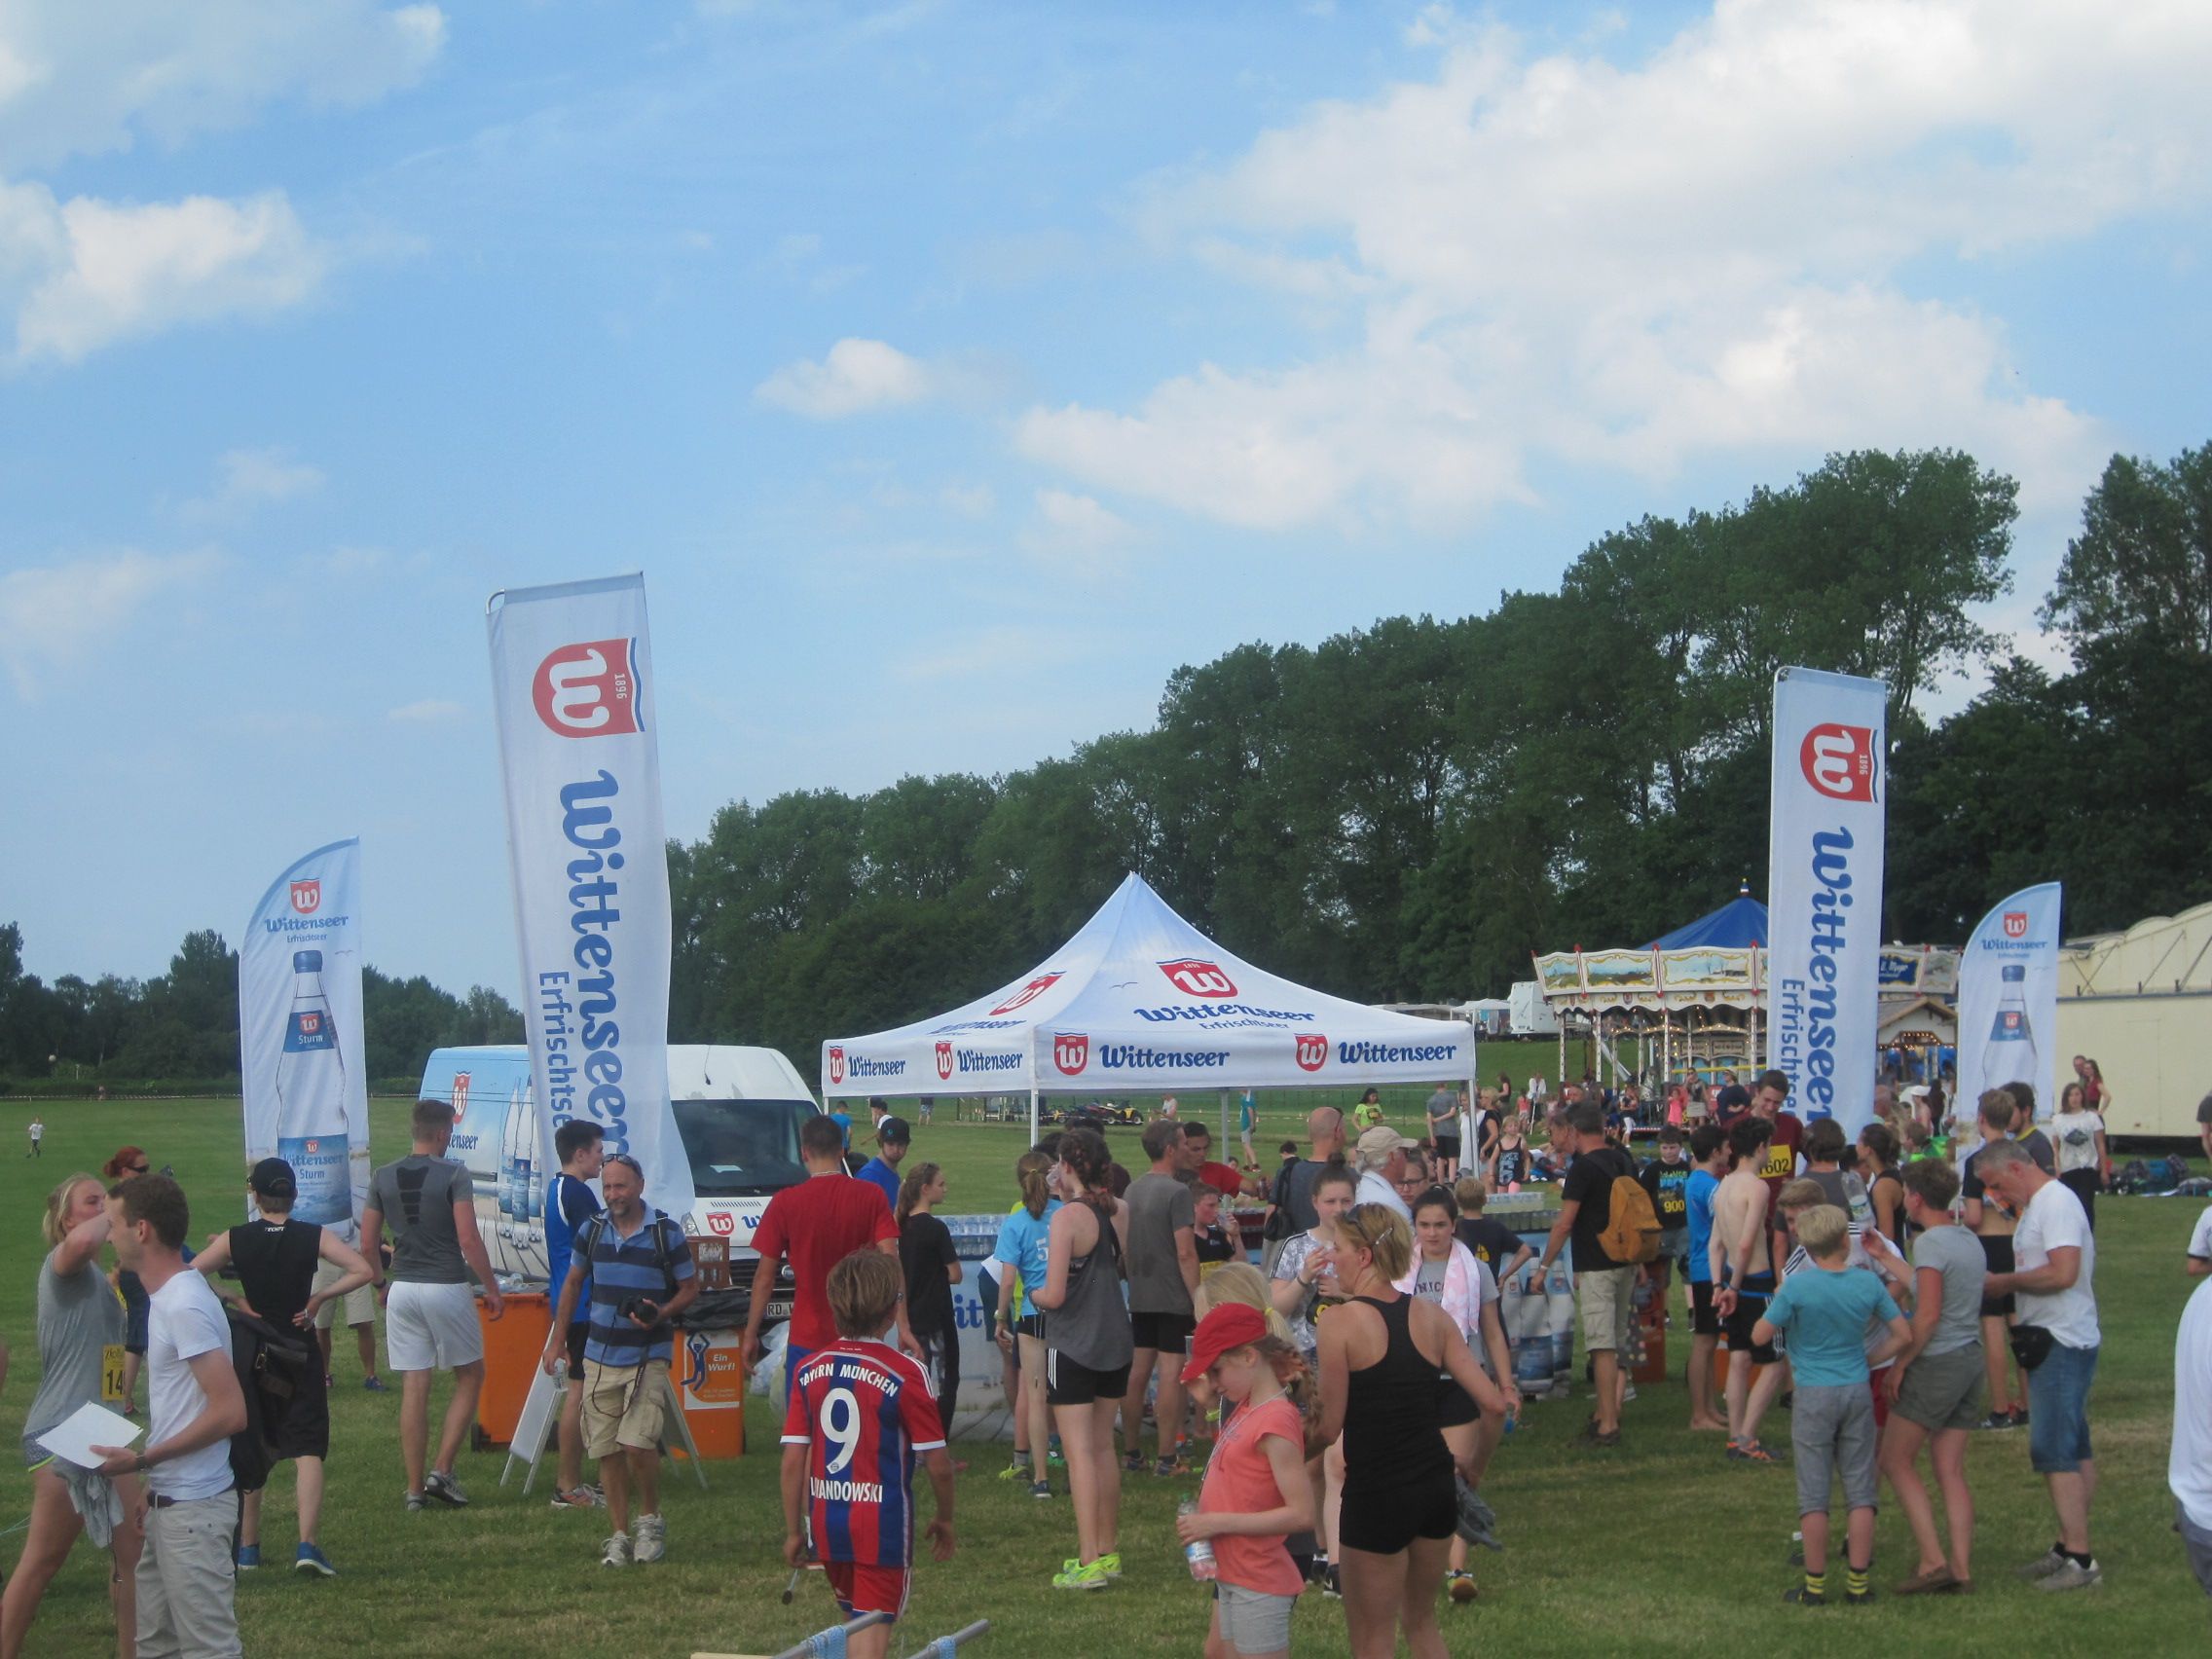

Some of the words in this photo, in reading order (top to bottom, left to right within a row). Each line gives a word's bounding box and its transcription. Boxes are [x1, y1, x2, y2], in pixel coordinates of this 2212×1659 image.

[614, 673, 627, 699] 1896
[265, 916, 350, 933] Wittenseer
[1980, 940, 2047, 950] Wittenseer
[560, 769, 630, 1155] Wittenseer
[1133, 1004, 1315, 1021] Wittenseer
[298, 1033, 323, 1045] Sturm
[539, 972, 577, 1127] Erfrischtse
[1099, 1045, 1231, 1068] Wittenseer
[1338, 1042, 1457, 1064] Wittenseer
[848, 1056, 906, 1078] Wittenseer
[956, 1050, 1023, 1072] Wittenseer
[449, 1133, 478, 1150] enseer
[299, 1169, 325, 1180] Sturm
[1760, 1160, 1789, 1174] 602
[1664, 1199, 1684, 1213] 900
[767, 1304, 783, 1315] RD
[708, 1363, 736, 1372] Wurf!
[839, 1364, 899, 1397] MÜNCHEN
[820, 1387, 861, 1475] 9
[810, 1477, 883, 1503] LANDOWSKI
